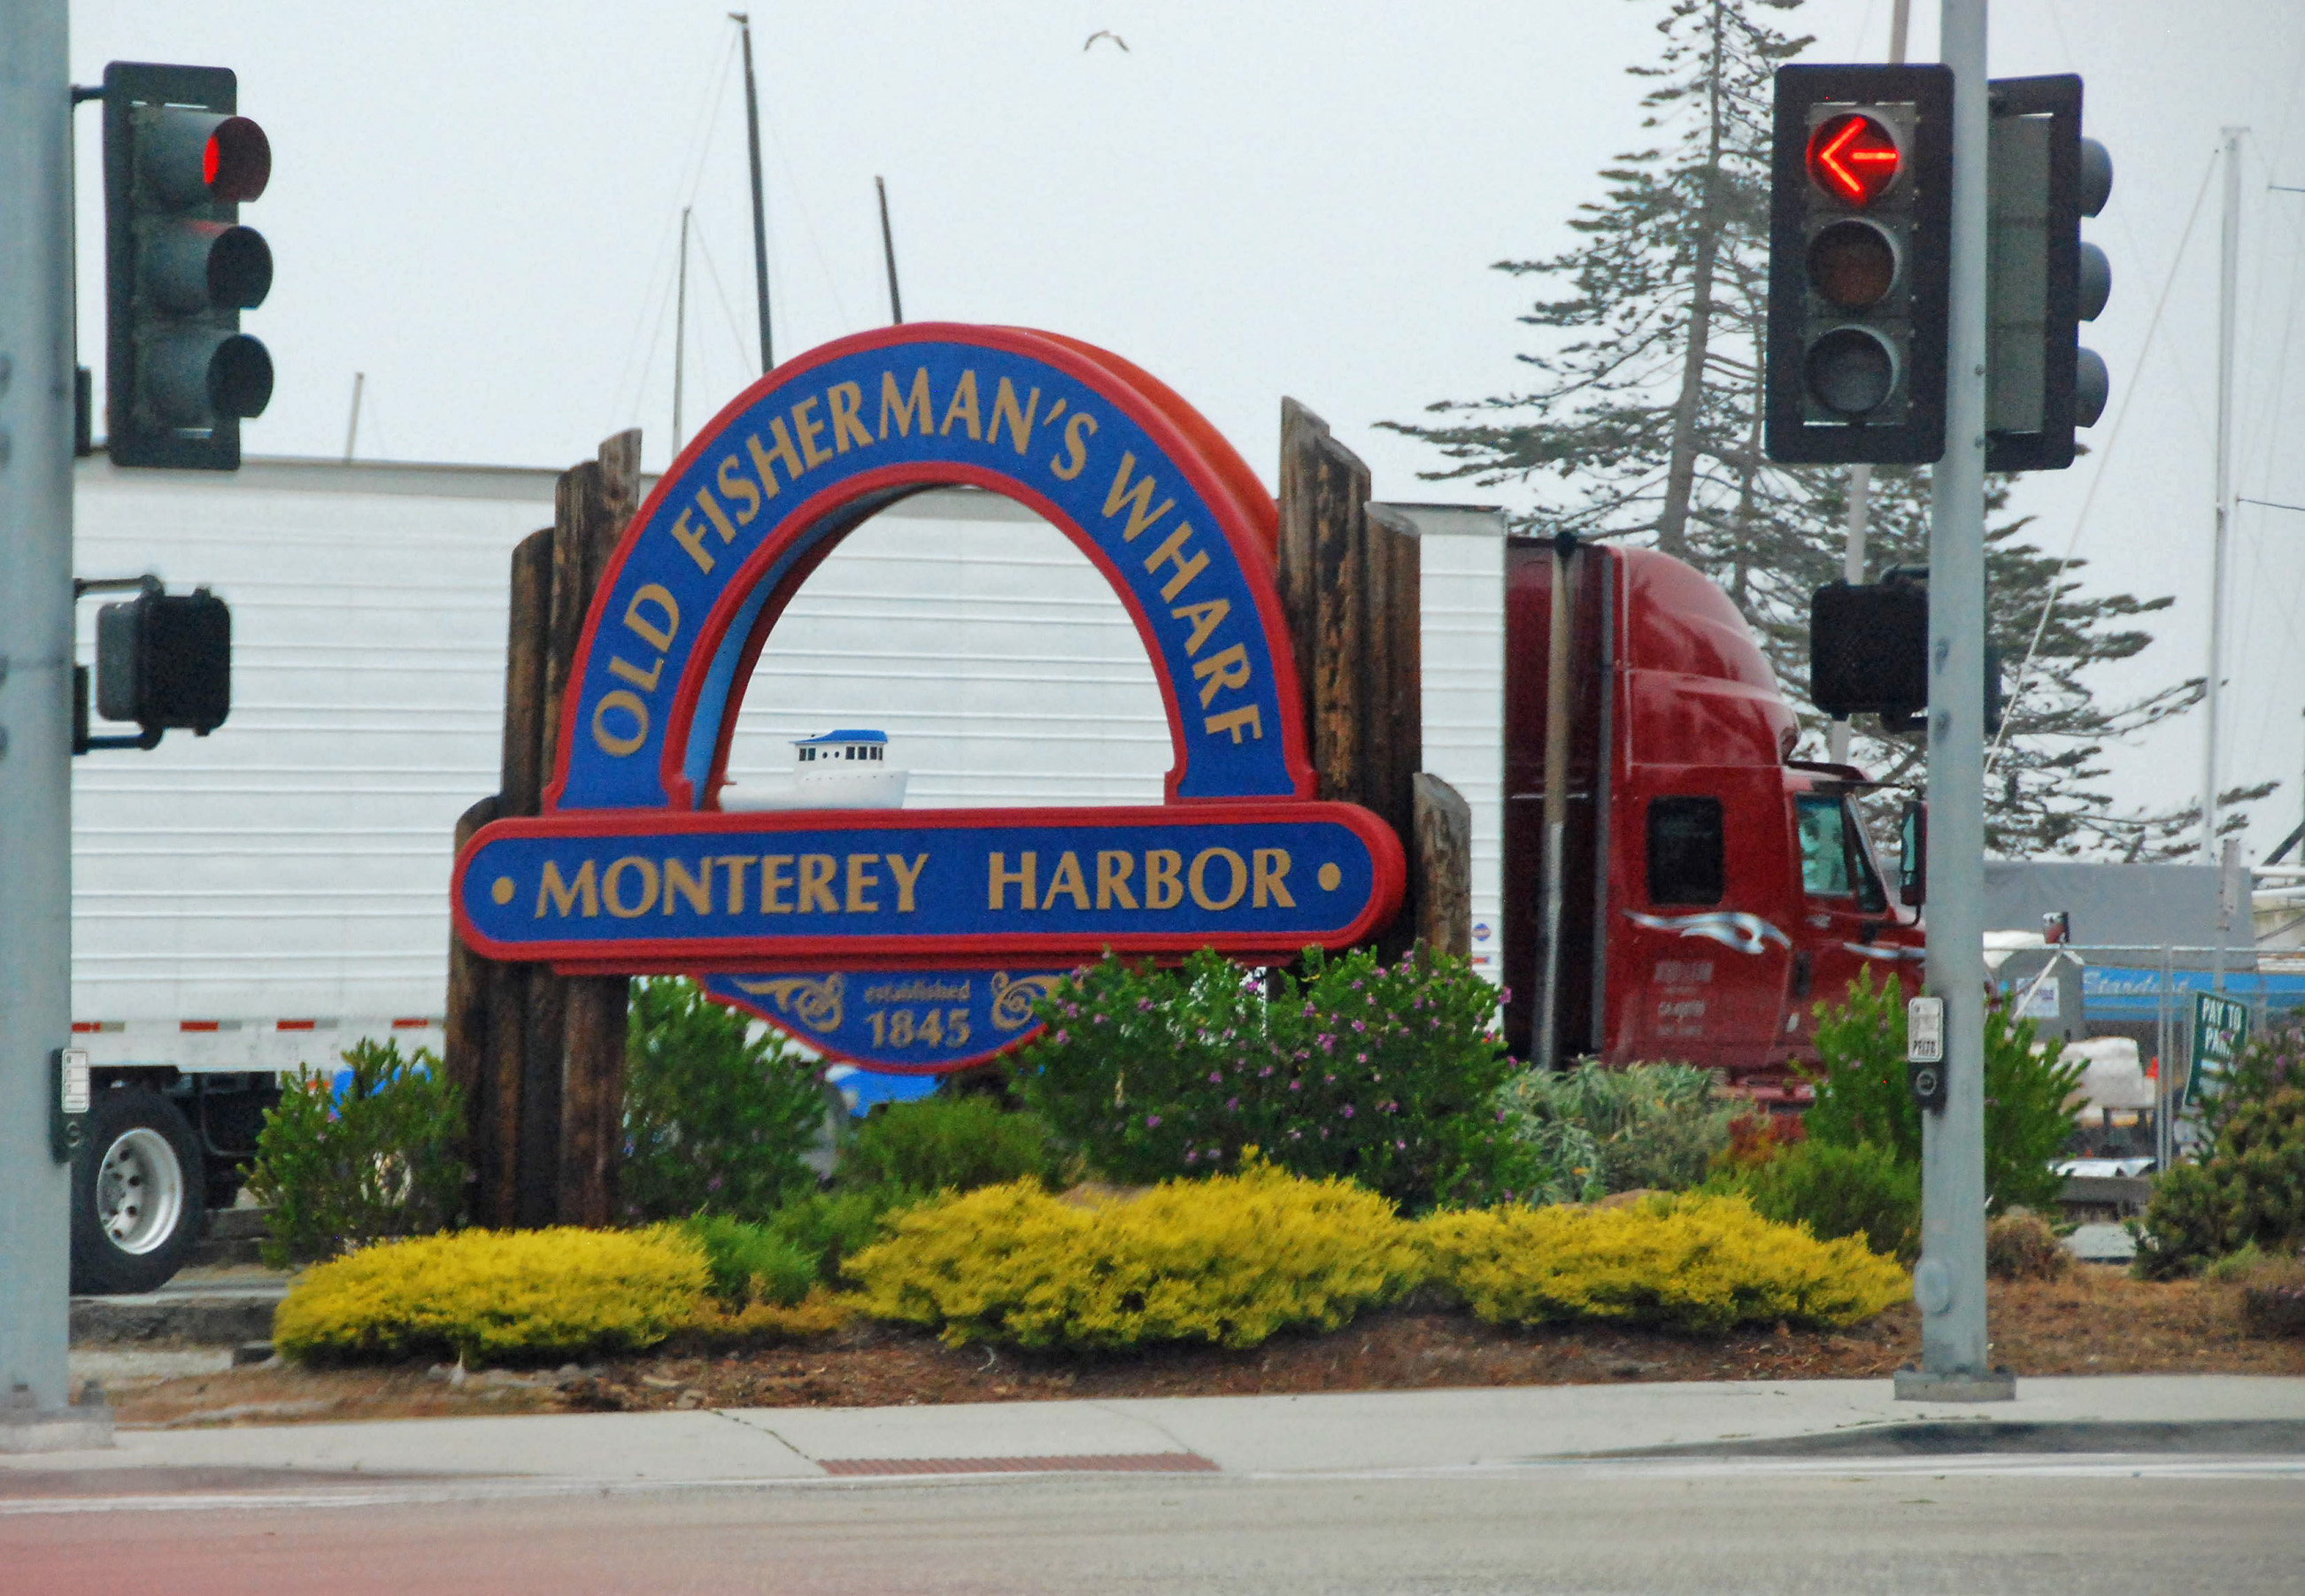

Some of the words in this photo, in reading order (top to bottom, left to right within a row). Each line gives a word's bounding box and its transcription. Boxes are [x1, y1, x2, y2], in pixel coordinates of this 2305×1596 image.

[594, 583, 680, 755] OLD
[671, 367, 1098, 574] FISHERMAN'S
[1101, 451, 1263, 744] WHARF
[535, 852, 929, 919] MONTEREY
[988, 847, 1297, 910] HARBOR
[863, 1008, 970, 1048] 1845
[2202, 997, 2224, 1025] PAY
[2227, 1003, 2242, 1032] TO
